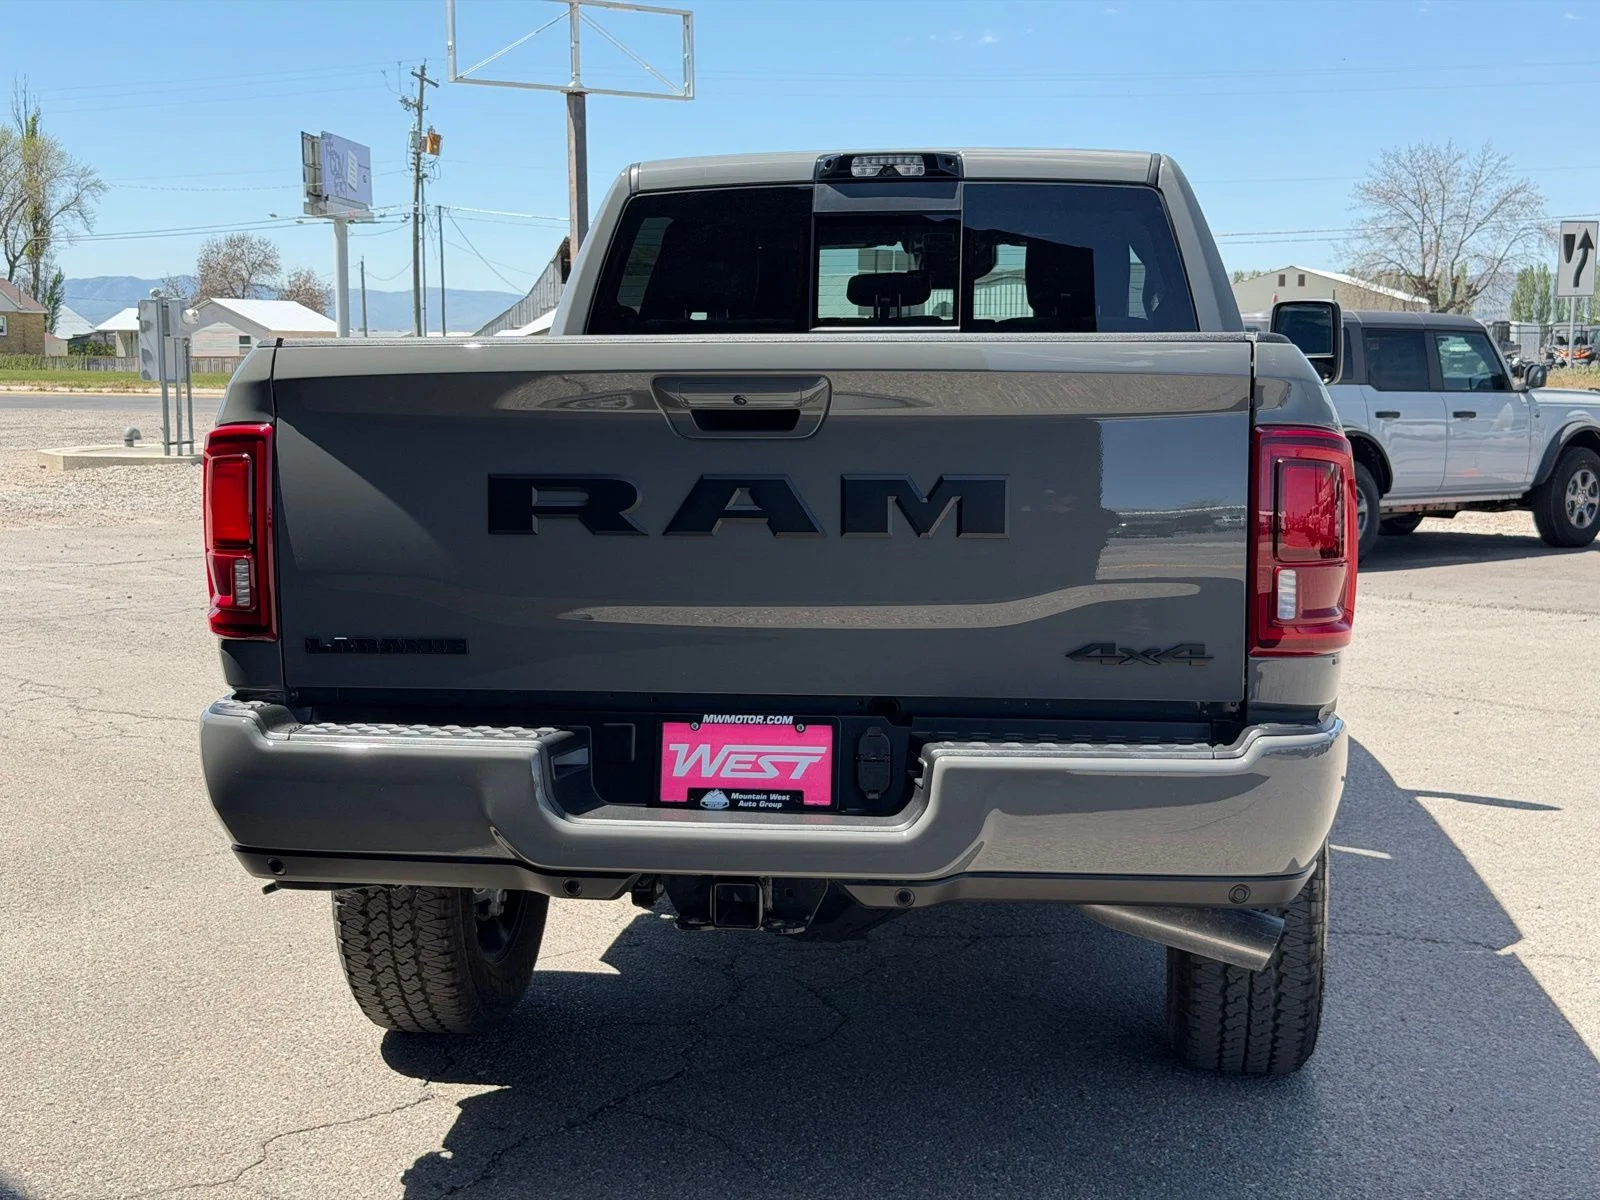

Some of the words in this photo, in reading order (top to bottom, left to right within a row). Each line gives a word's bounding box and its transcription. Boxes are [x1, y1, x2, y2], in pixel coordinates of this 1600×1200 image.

[488, 473, 1011, 538] RAM
[1066, 642, 1214, 666] 4x4
[702, 714, 794, 725] MWMOTOR.COM
[668, 743, 827, 780] WEST
[730, 792, 767, 801] Mountain
[769, 793, 790, 801] West
[738, 800, 757, 808] Auto
[759, 801, 782, 809] Group
